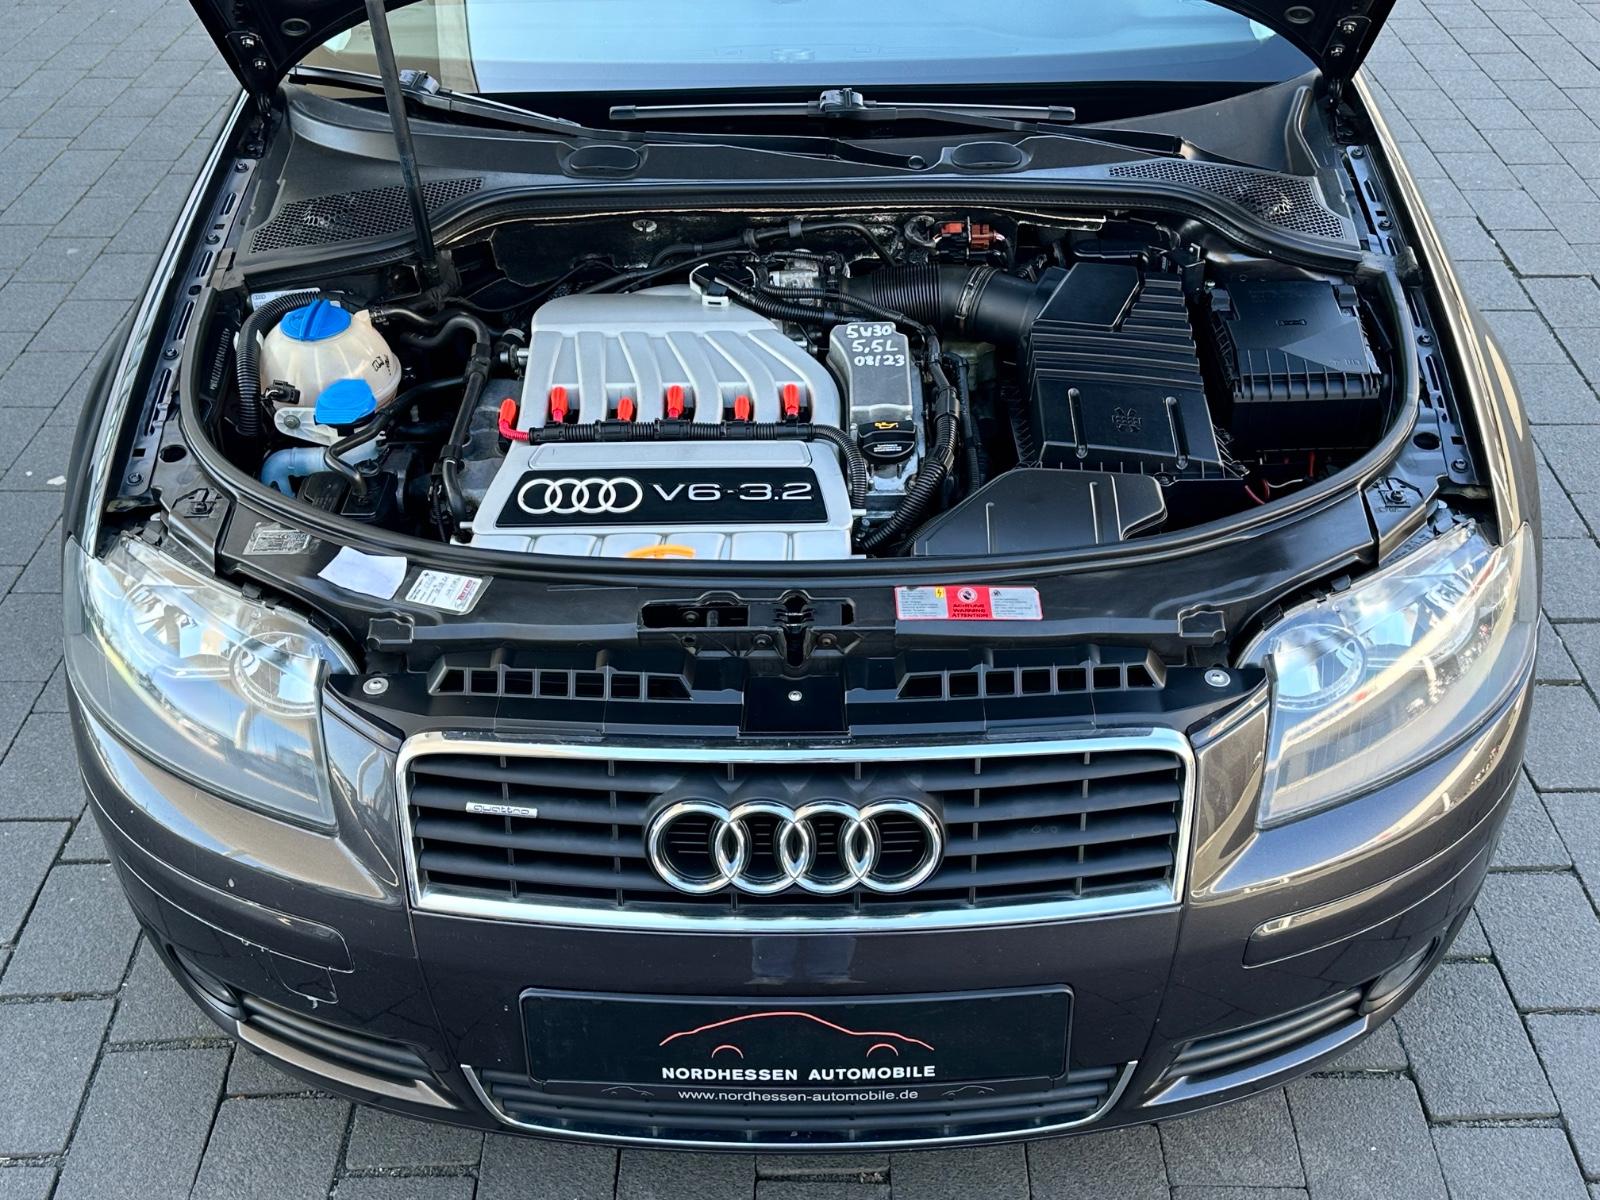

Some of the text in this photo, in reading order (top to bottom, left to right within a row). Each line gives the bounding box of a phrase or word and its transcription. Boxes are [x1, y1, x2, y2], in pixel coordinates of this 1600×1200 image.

[846, 325, 892, 338] 5W30
[854, 355, 905, 366] 08/23
[474, 804, 529, 815] quattro
[661, 1065, 936, 1081] NORDHESSEN AUTOMOBILE
[677, 1088, 919, 1102] www.nordhessen-automobile.de
